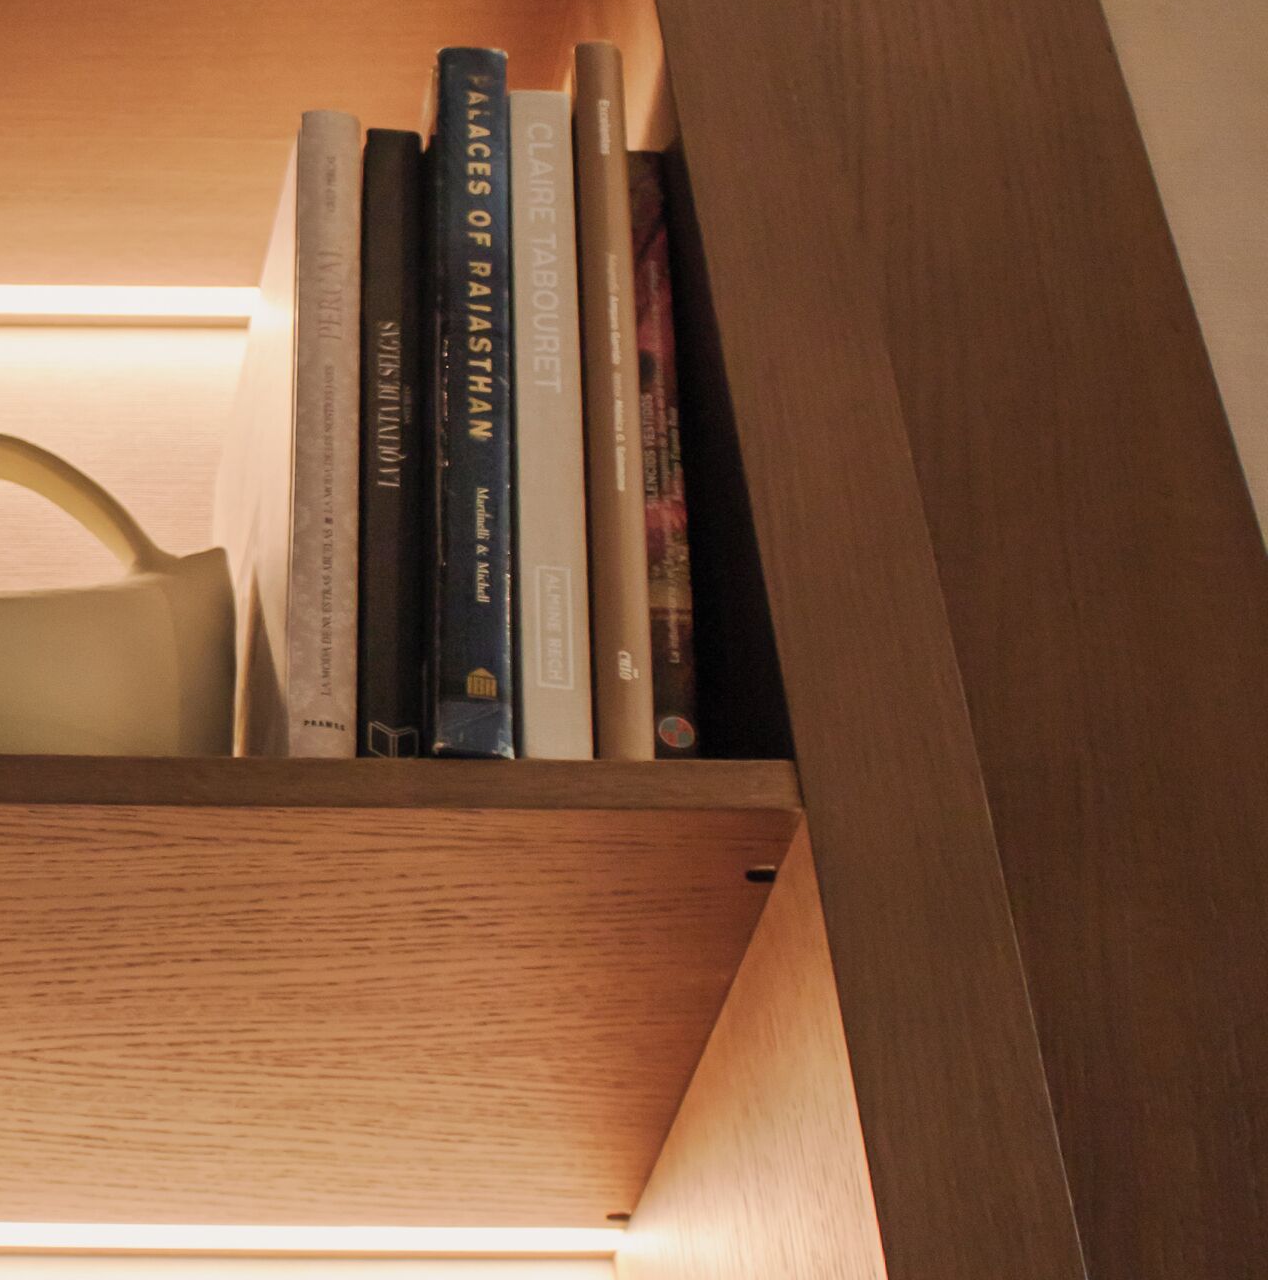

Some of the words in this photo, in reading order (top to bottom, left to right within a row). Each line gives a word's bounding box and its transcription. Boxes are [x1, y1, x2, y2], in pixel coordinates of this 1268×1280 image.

[466, 74, 491, 193] PALACES
[527, 121, 556, 223] CLAIRE
[466, 209, 491, 244] OF
[529, 232, 561, 391] TABOURET
[377, 320, 401, 380] SELGAS
[377, 382, 400, 401] DE
[377, 405, 407, 463] QUINTA
[376, 466, 400, 488] LA
[474, 485, 489, 538] Martinelli
[322, 529, 333, 573] ABUELAS
[474, 540, 490, 553] &
[474, 558, 490, 602] Michell
[544, 570, 562, 631] ALMINE
[321, 633, 331, 644] DE
[546, 636, 563, 680] RECH
[320, 646, 331, 678] MODA
[320, 680, 331, 697] LA
